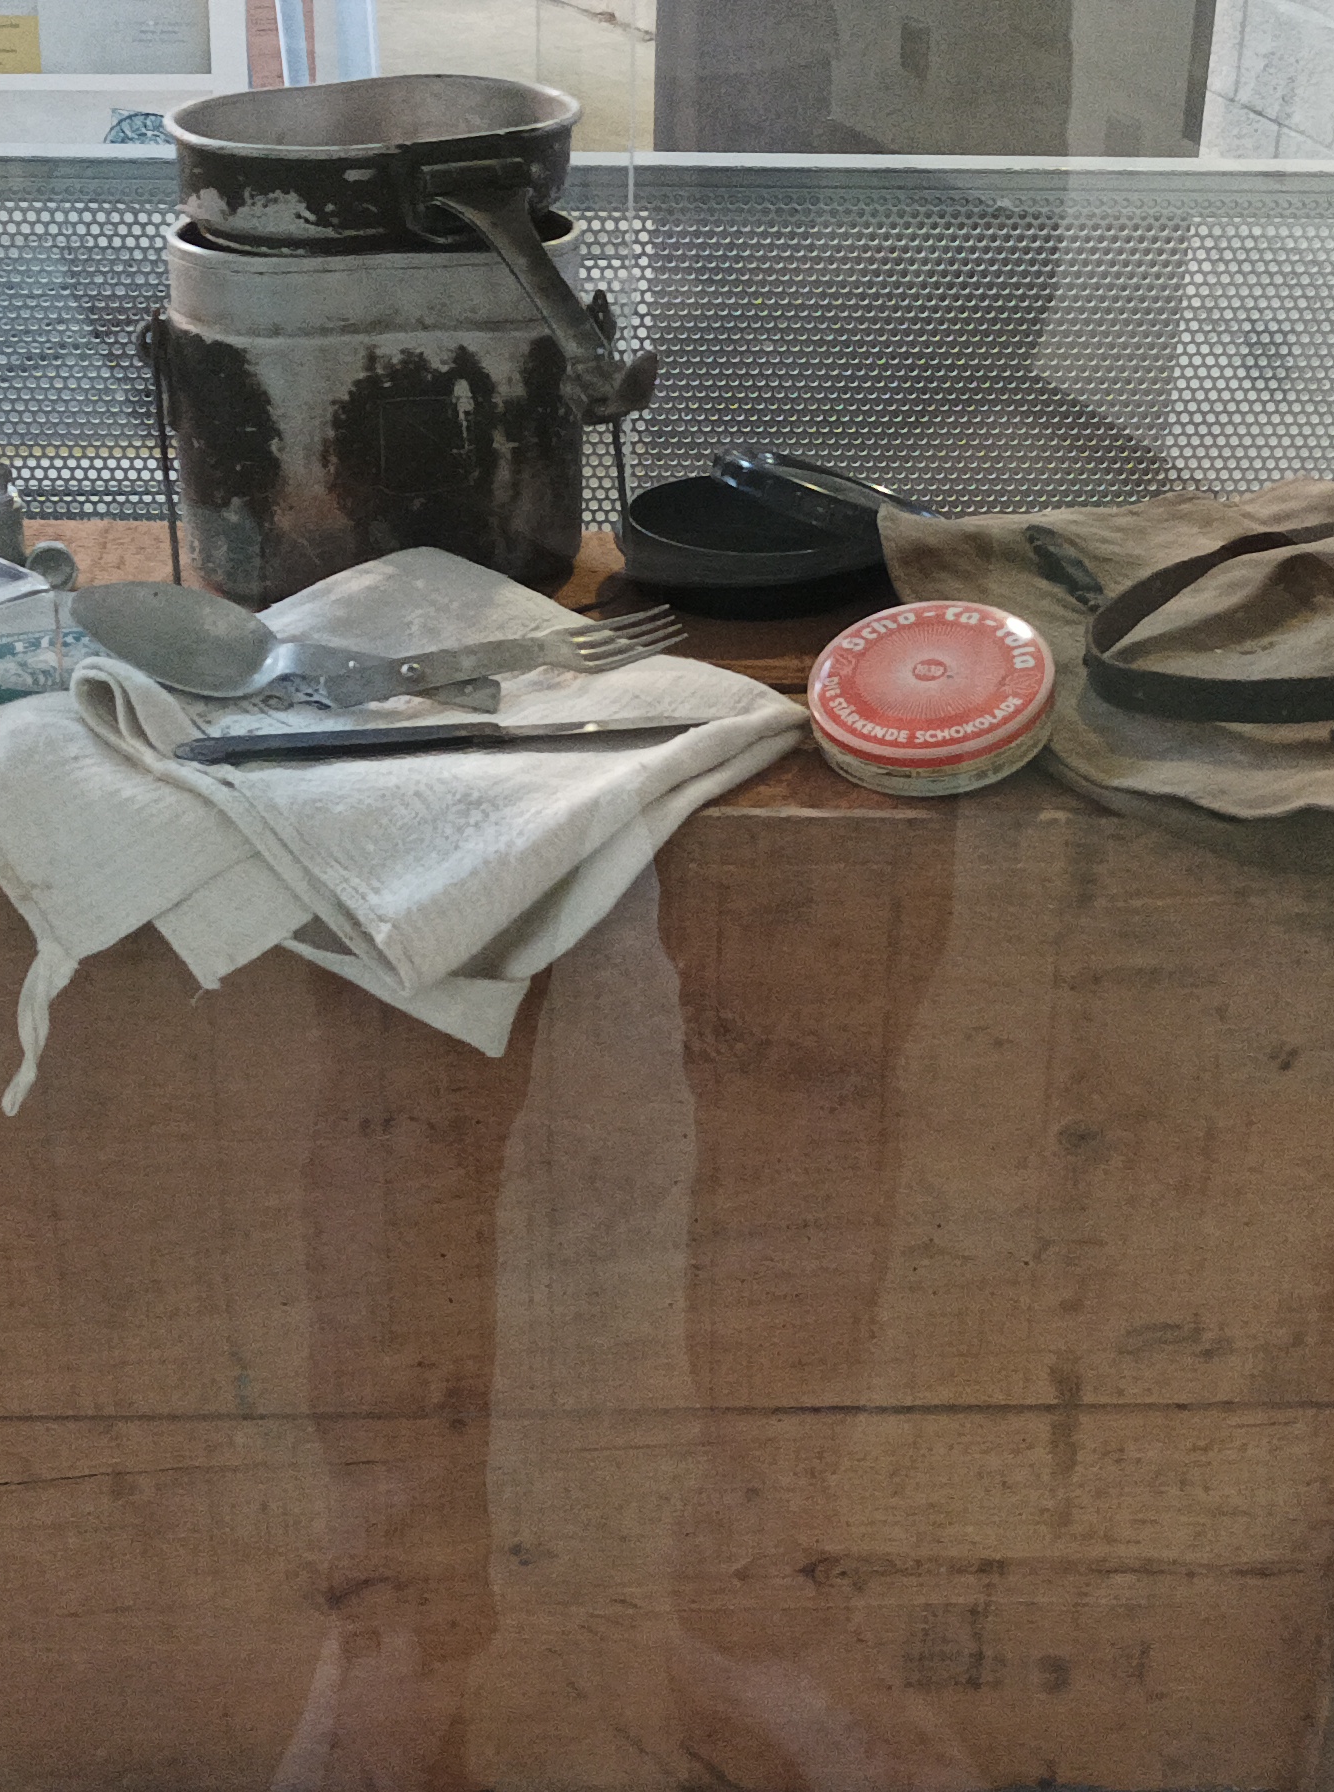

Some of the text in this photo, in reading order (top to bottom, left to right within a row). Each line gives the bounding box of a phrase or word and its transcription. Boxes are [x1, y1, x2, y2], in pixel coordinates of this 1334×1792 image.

[824, 676, 1023, 743] DIE STÄRKENDE SCHOKOLADE
